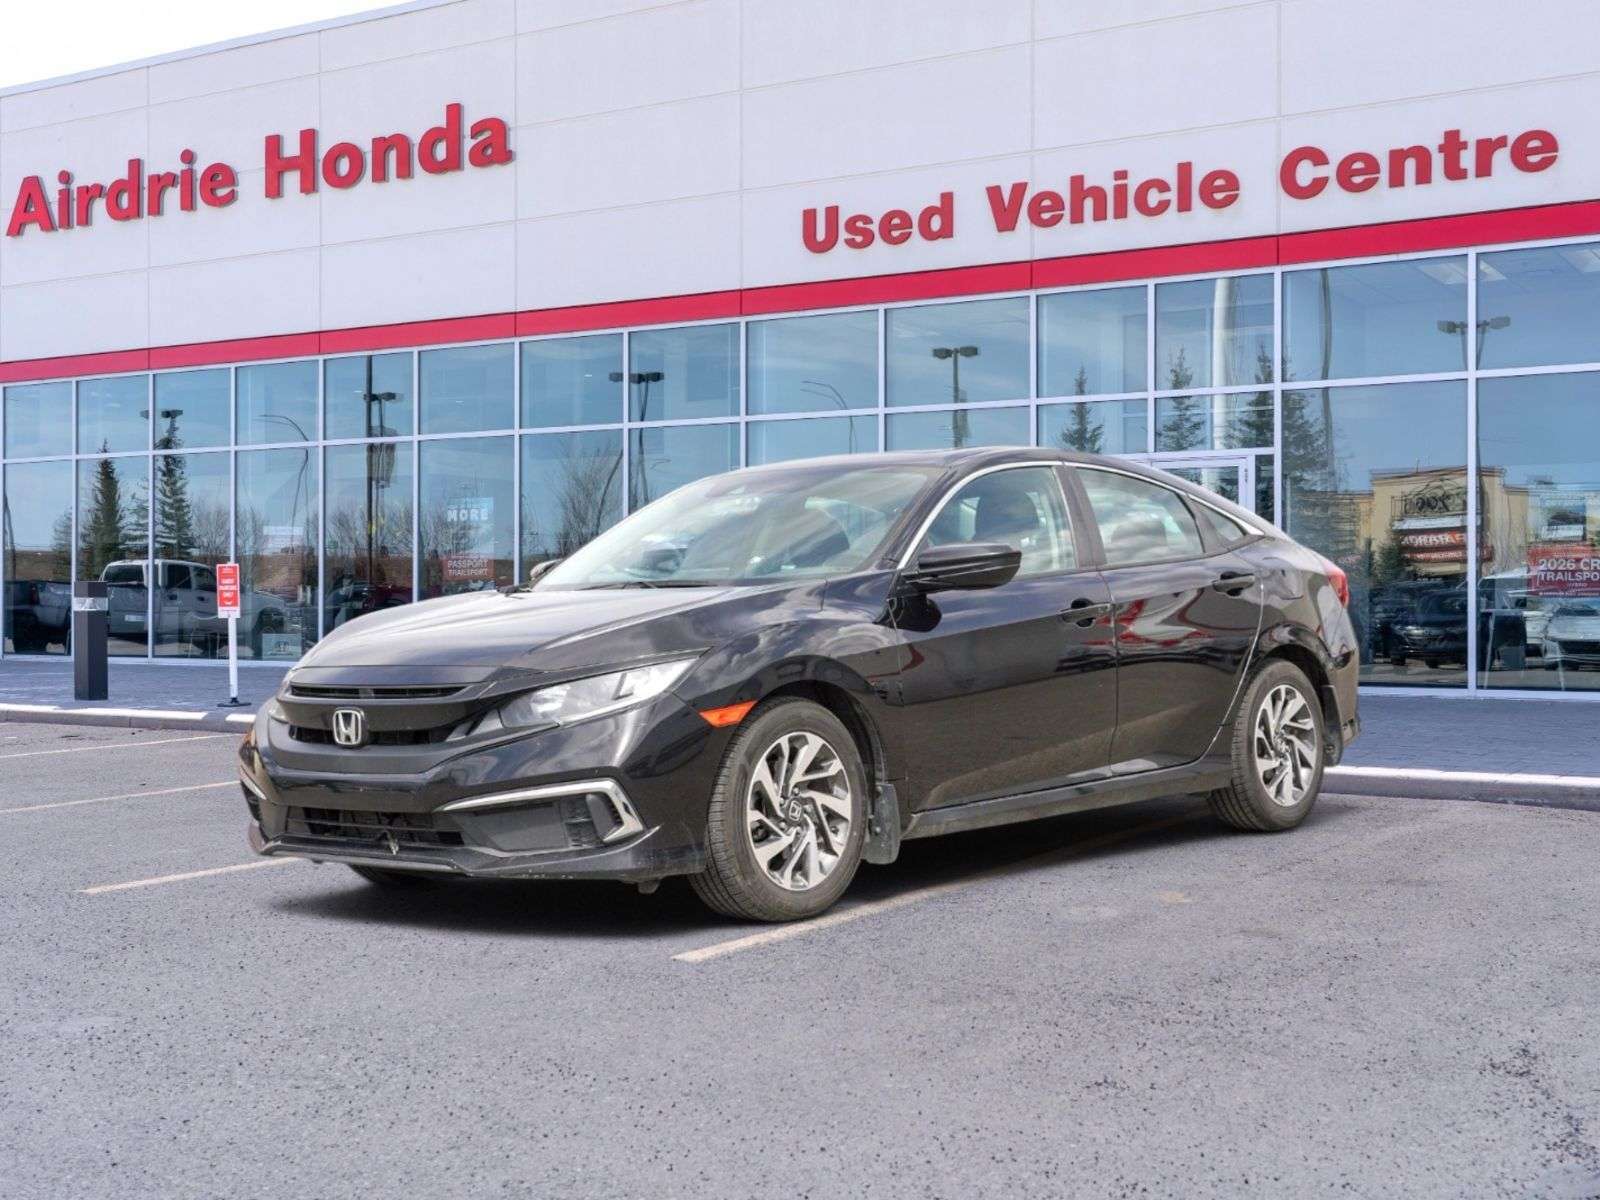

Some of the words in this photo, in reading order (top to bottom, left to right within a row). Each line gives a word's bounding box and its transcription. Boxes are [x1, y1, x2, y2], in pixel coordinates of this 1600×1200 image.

[6, 150, 237, 237] Airdrie
[264, 102, 513, 199] Honda
[802, 191, 954, 253] Used
[986, 161, 1240, 232] Vehicle
[1279, 129, 1559, 200] Centre
[447, 509, 489, 521] MORE
[1539, 558, 1576, 571] 2026
